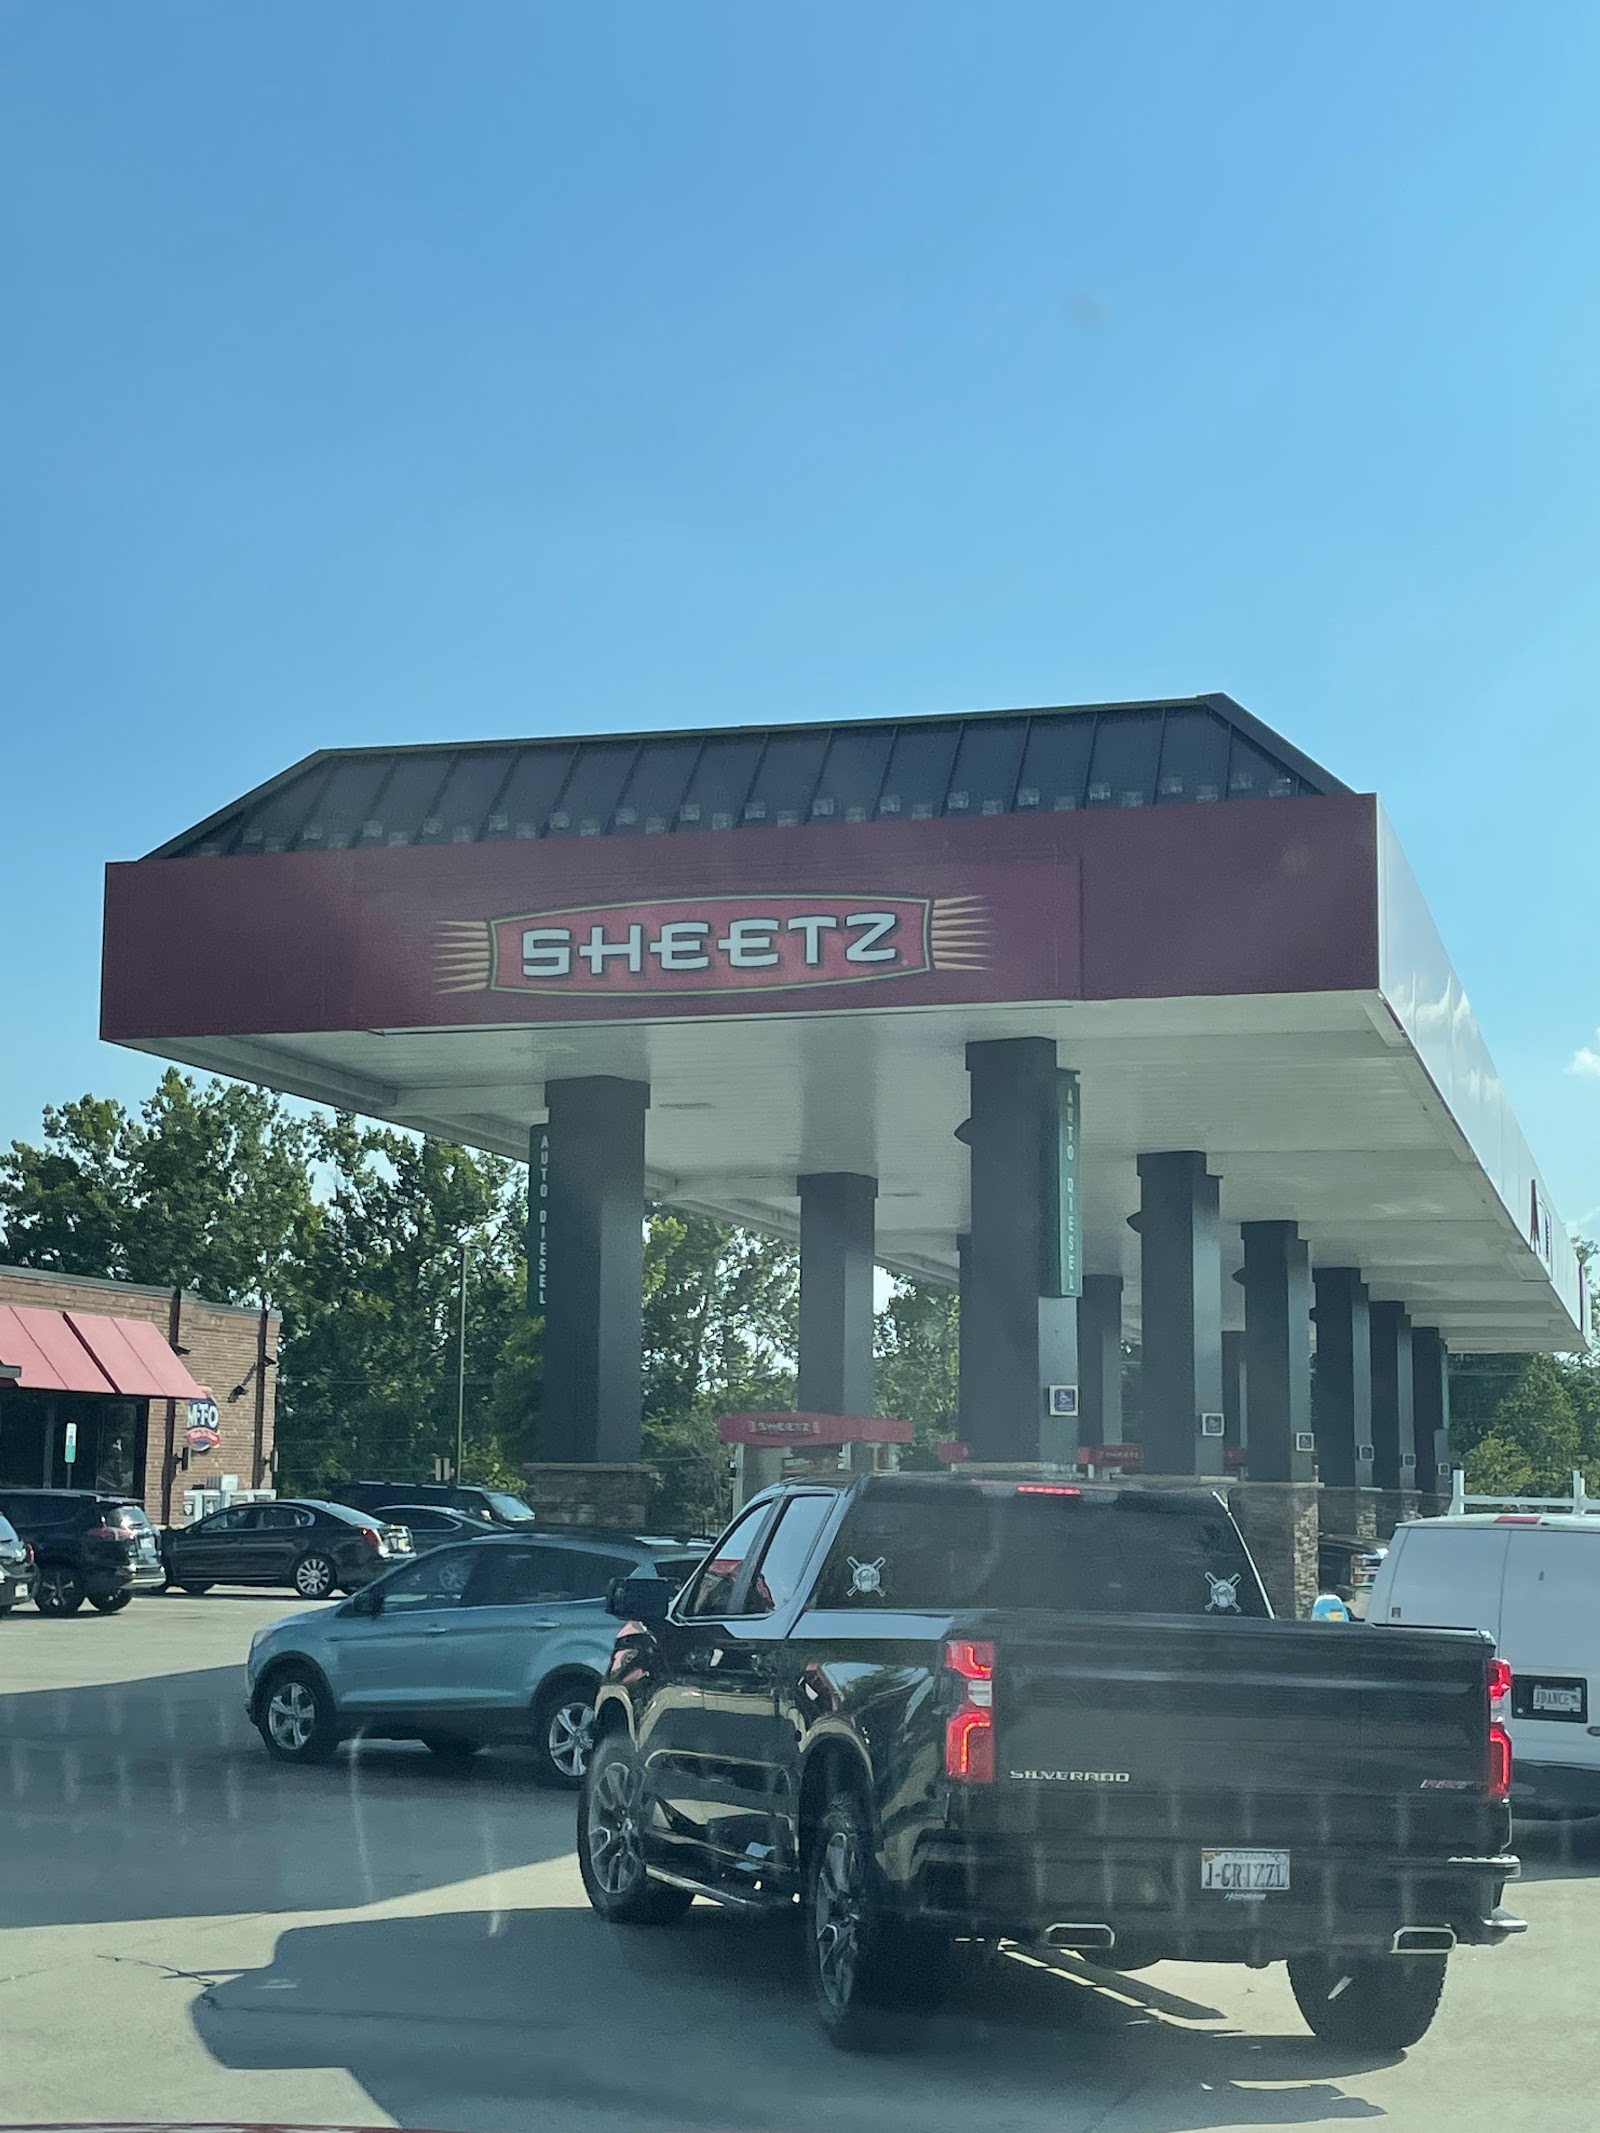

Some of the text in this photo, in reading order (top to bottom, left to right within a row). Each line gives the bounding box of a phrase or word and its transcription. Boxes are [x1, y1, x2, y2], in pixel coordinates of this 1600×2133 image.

[521, 911, 898, 978] SHEETZ
[538, 1134, 549, 1305] AUTO DIESEL
[1066, 1087, 1074, 1290] AUTO DIESEL
[1009, 1769, 1130, 1782] SILVERADO
